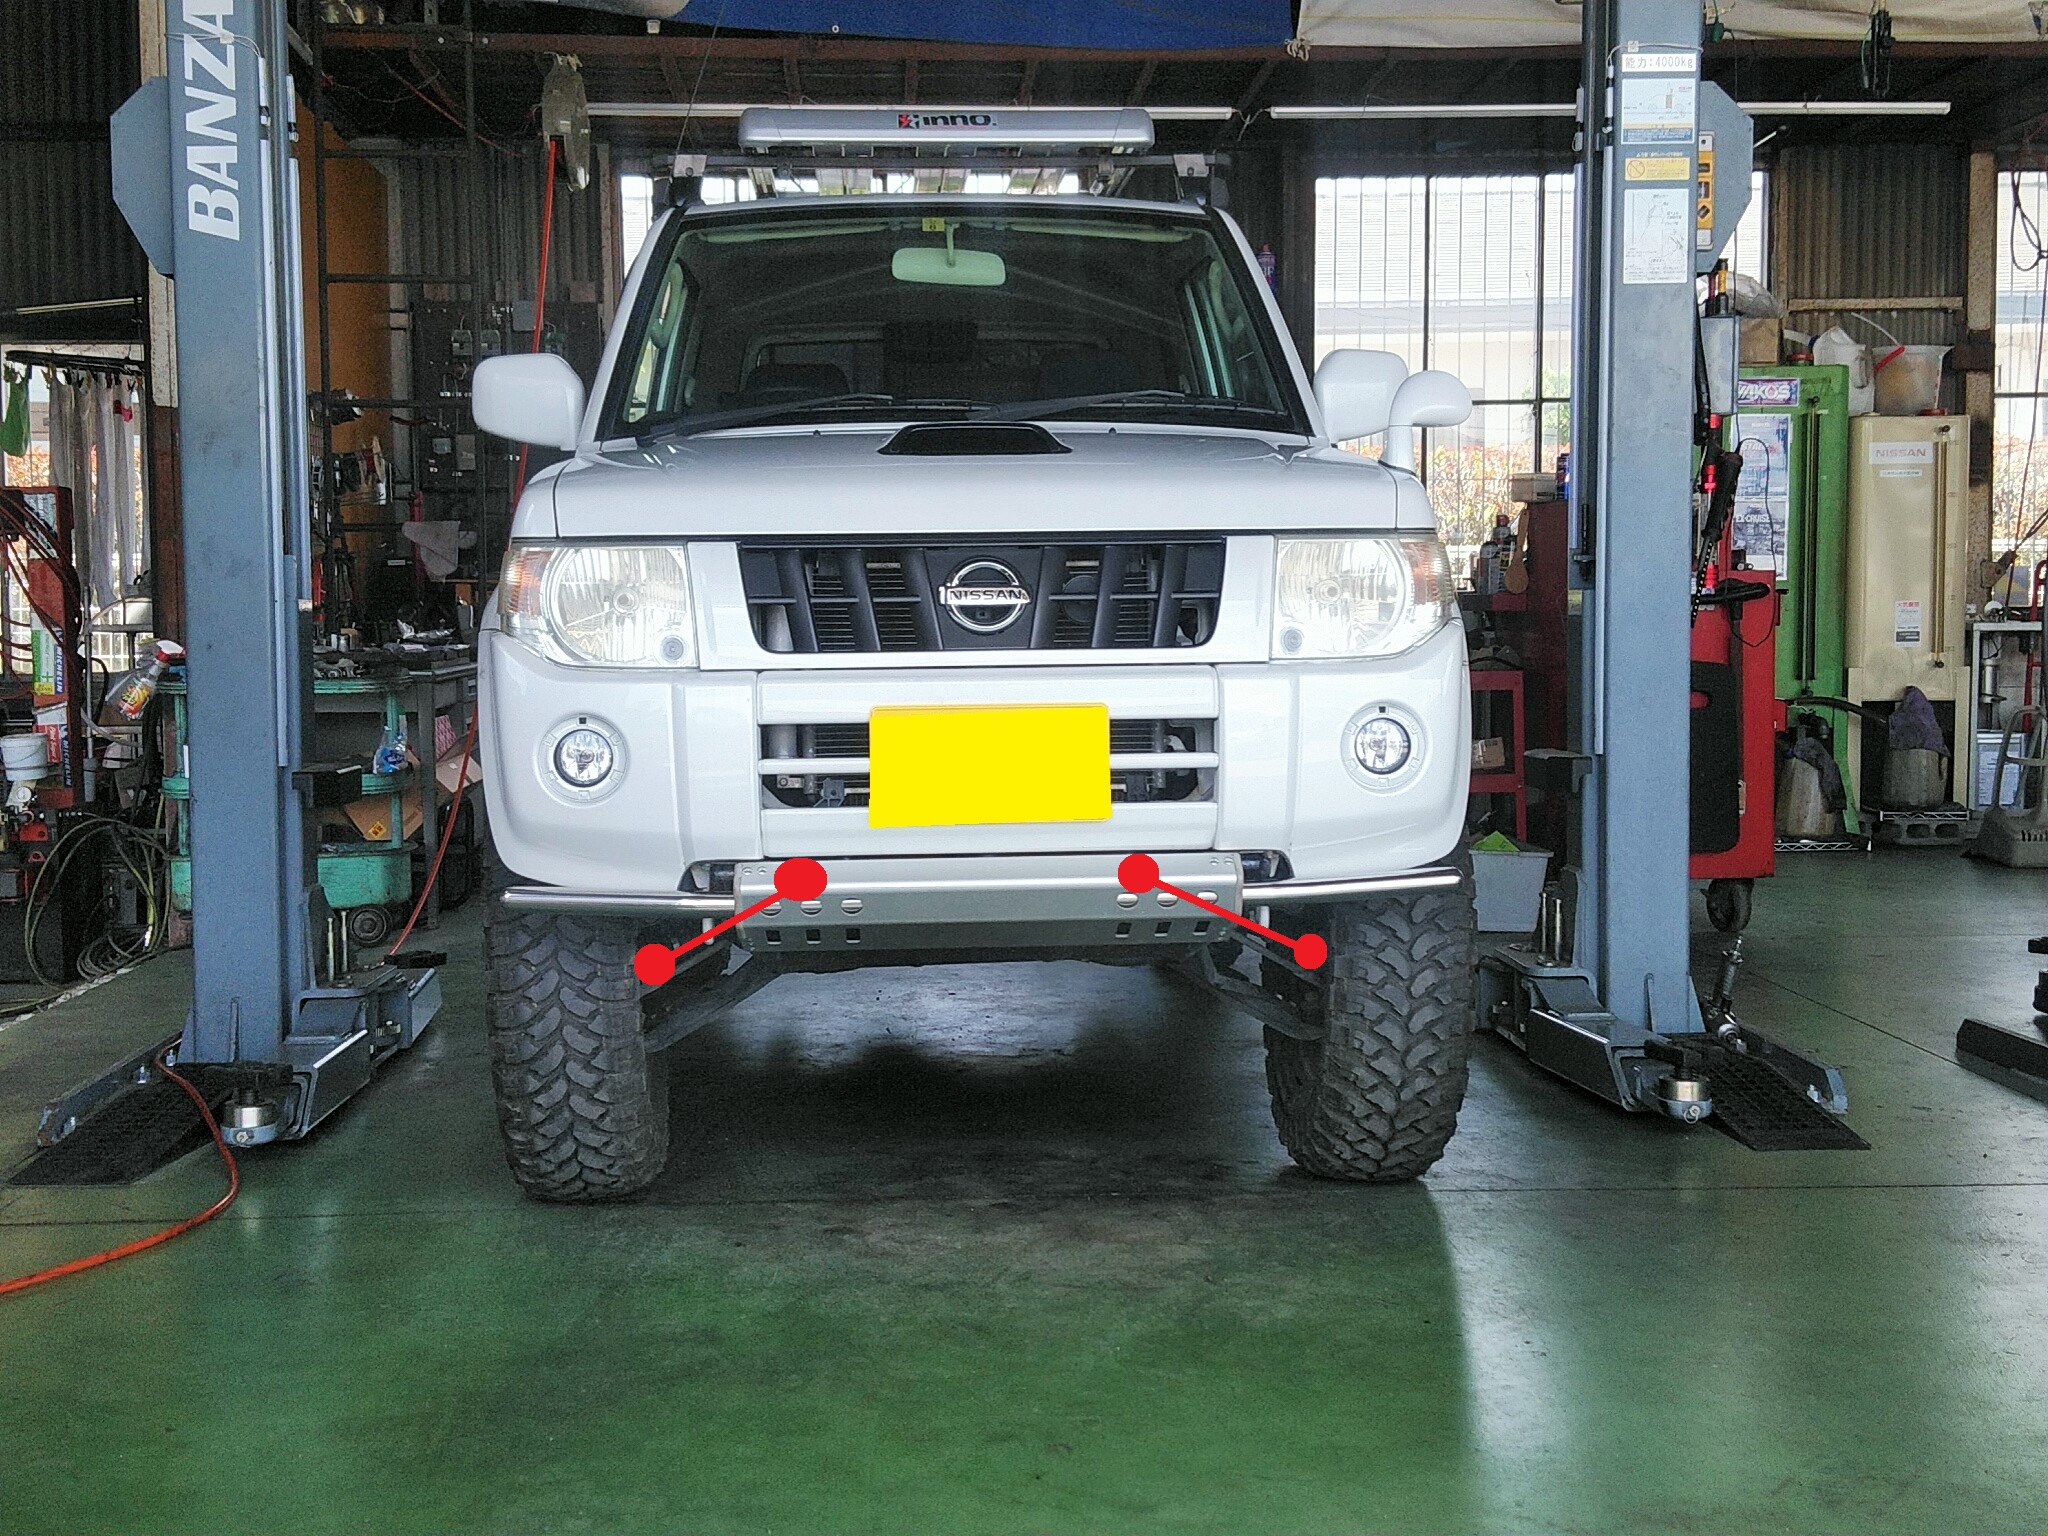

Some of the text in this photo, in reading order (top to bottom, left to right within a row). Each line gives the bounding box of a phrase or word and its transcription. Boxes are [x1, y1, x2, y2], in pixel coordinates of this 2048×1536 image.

[1876, 448, 1926, 457] NISSAN
[949, 590, 1022, 600] NISSAN
[63, 740, 72, 786] MICHELIN
